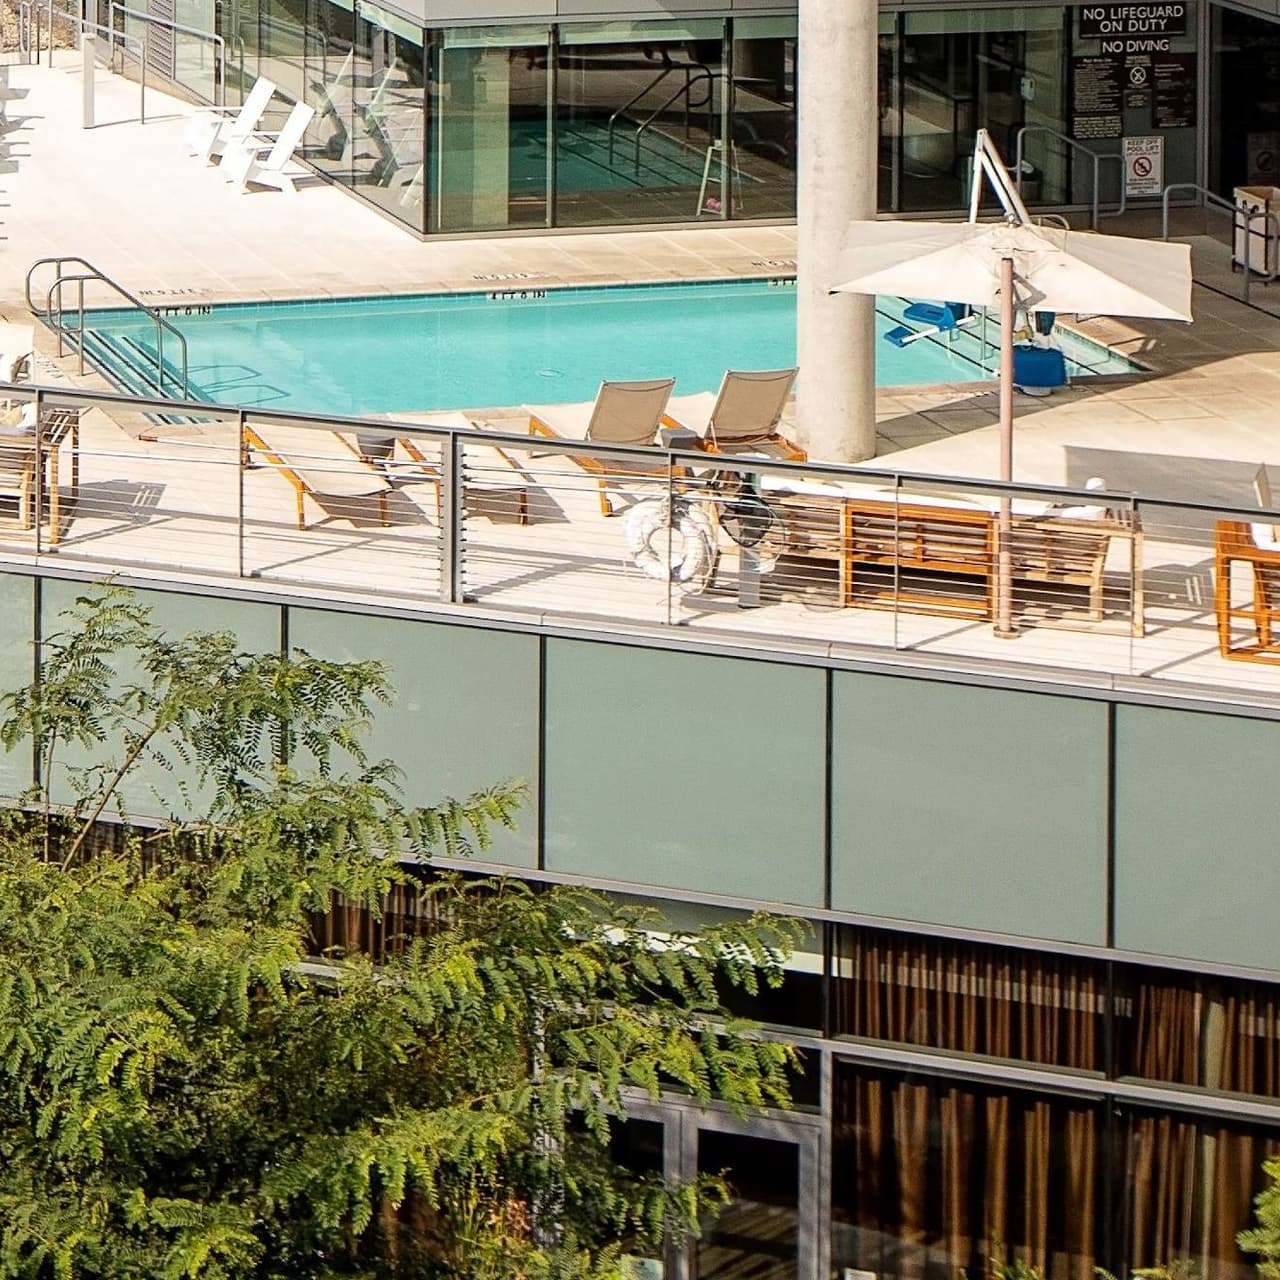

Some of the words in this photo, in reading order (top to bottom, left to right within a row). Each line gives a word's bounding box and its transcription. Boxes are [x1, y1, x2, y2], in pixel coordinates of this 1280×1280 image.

[1083, 8, 1105, 20] NO
[1110, 5, 1184, 19] LIFEGUARD
[1099, 20, 1123, 32] ON
[1128, 18, 1168, 32] DUTY
[1102, 41, 1124, 53] NO
[1126, 39, 1170, 52] DIVING
